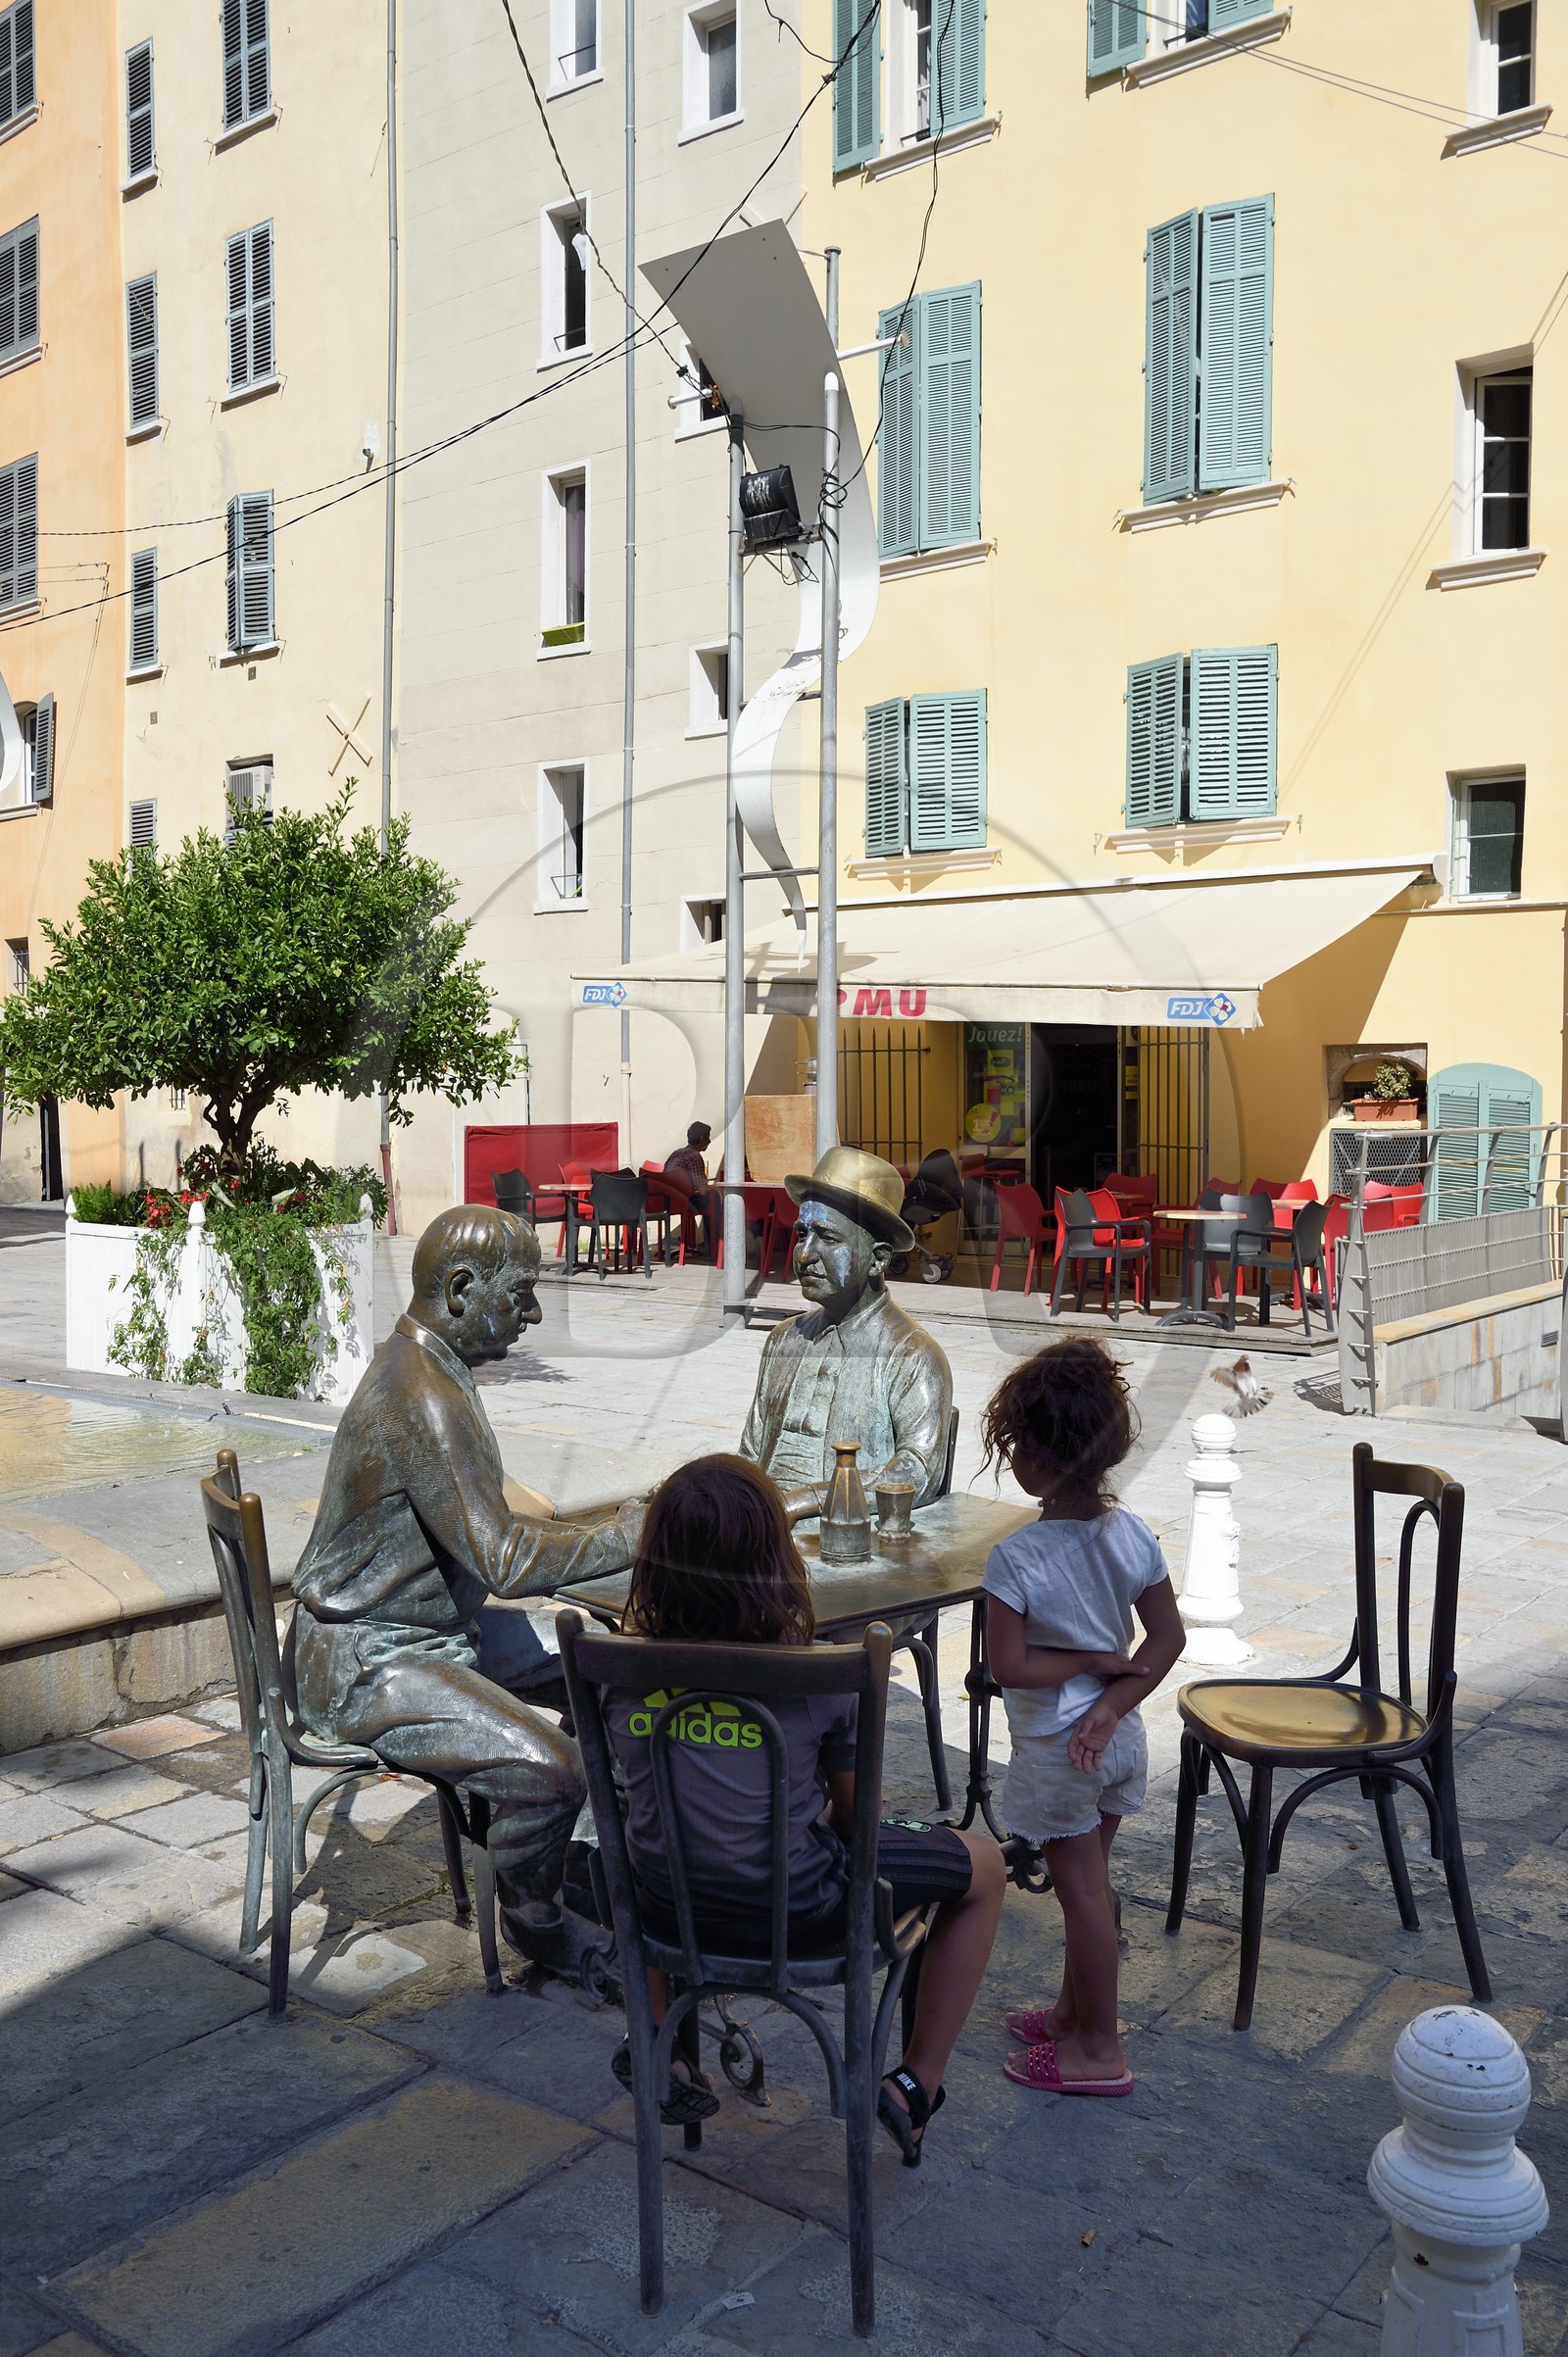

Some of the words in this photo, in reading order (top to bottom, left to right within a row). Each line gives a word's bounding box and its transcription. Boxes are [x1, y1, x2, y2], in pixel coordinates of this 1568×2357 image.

[584, 988, 607, 1001] FDJ
[1170, 1001, 1203, 1016] FDJ
[968, 1026, 1023, 1043] Jouez!
[896, 2072, 916, 2091] NIKE
